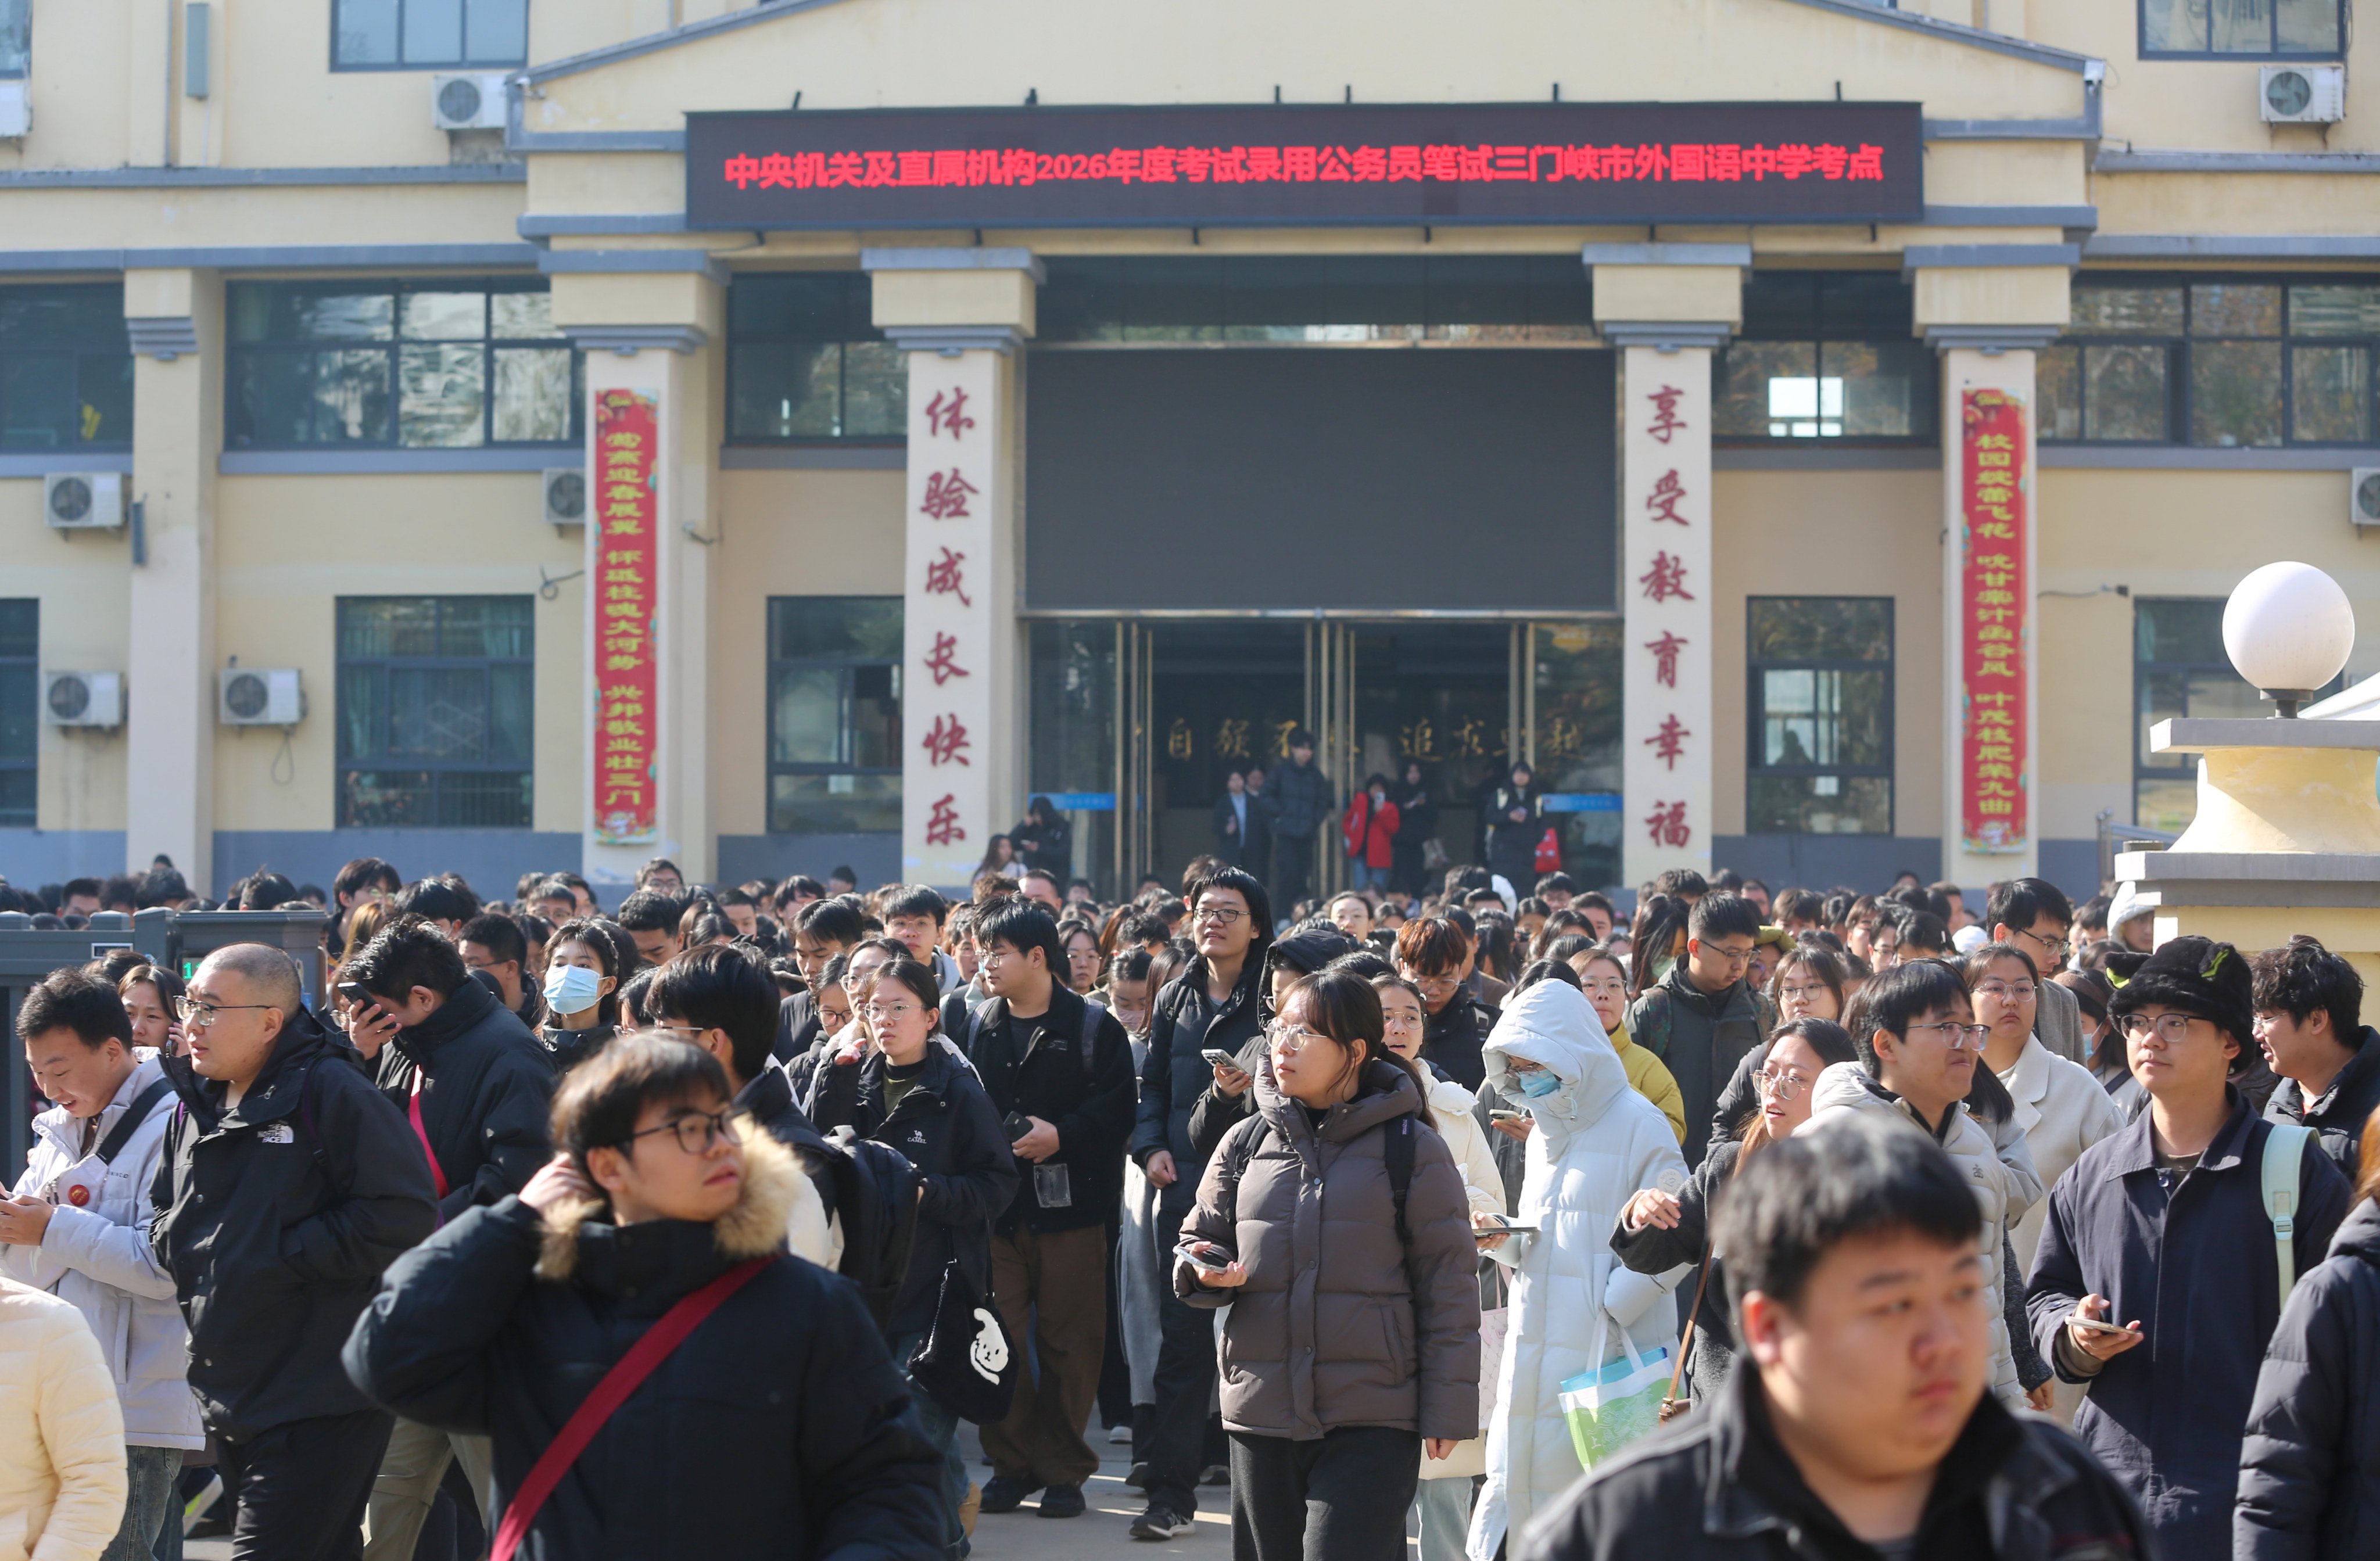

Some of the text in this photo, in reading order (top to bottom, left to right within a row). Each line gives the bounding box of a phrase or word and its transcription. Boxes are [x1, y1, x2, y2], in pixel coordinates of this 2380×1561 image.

[724, 143, 1884, 190] 中央机关及直属机构2026年度考试录用公务员笔试三门峡市外国语中学考点
[604, 685, 644, 805] 兴邦敬业壮三门
[920, 386, 979, 846] 体验成长快乐
[1640, 385, 1695, 849] 享受教育幸福
